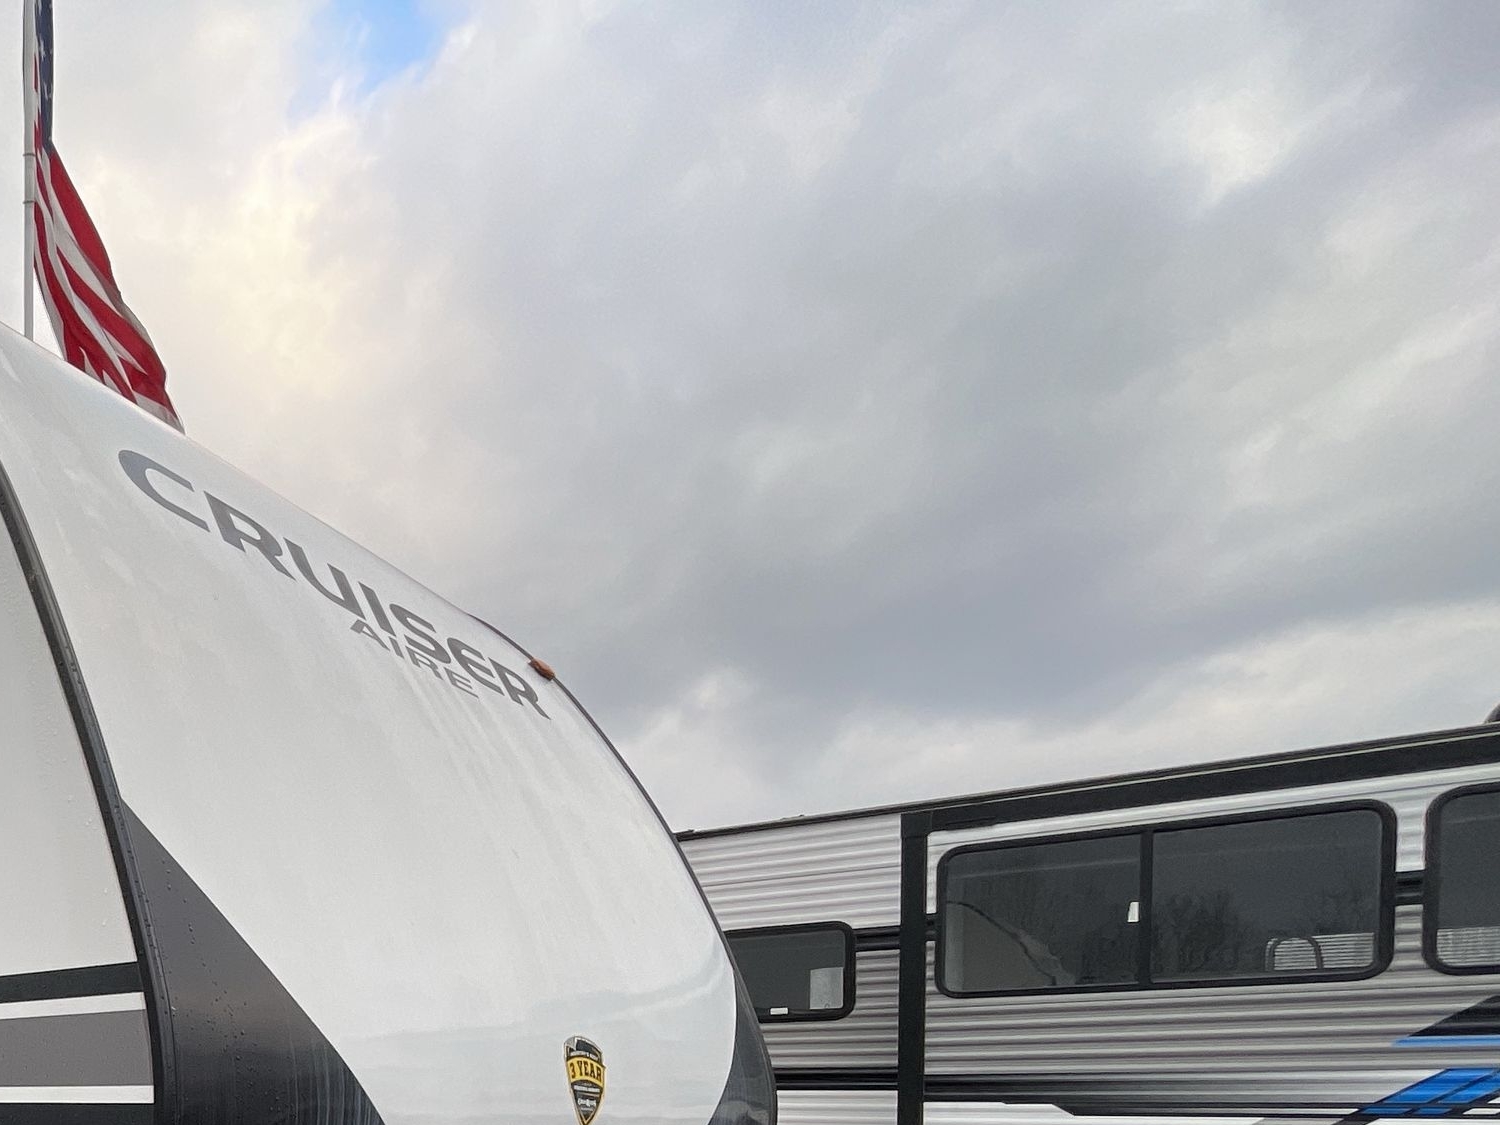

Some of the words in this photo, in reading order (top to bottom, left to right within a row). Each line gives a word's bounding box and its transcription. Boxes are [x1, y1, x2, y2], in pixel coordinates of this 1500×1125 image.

[118, 449, 550, 720] CRUISER
[350, 618, 479, 698] AIRE
[569, 1062, 576, 1079] 3
[577, 1060, 602, 1082] YEAR
